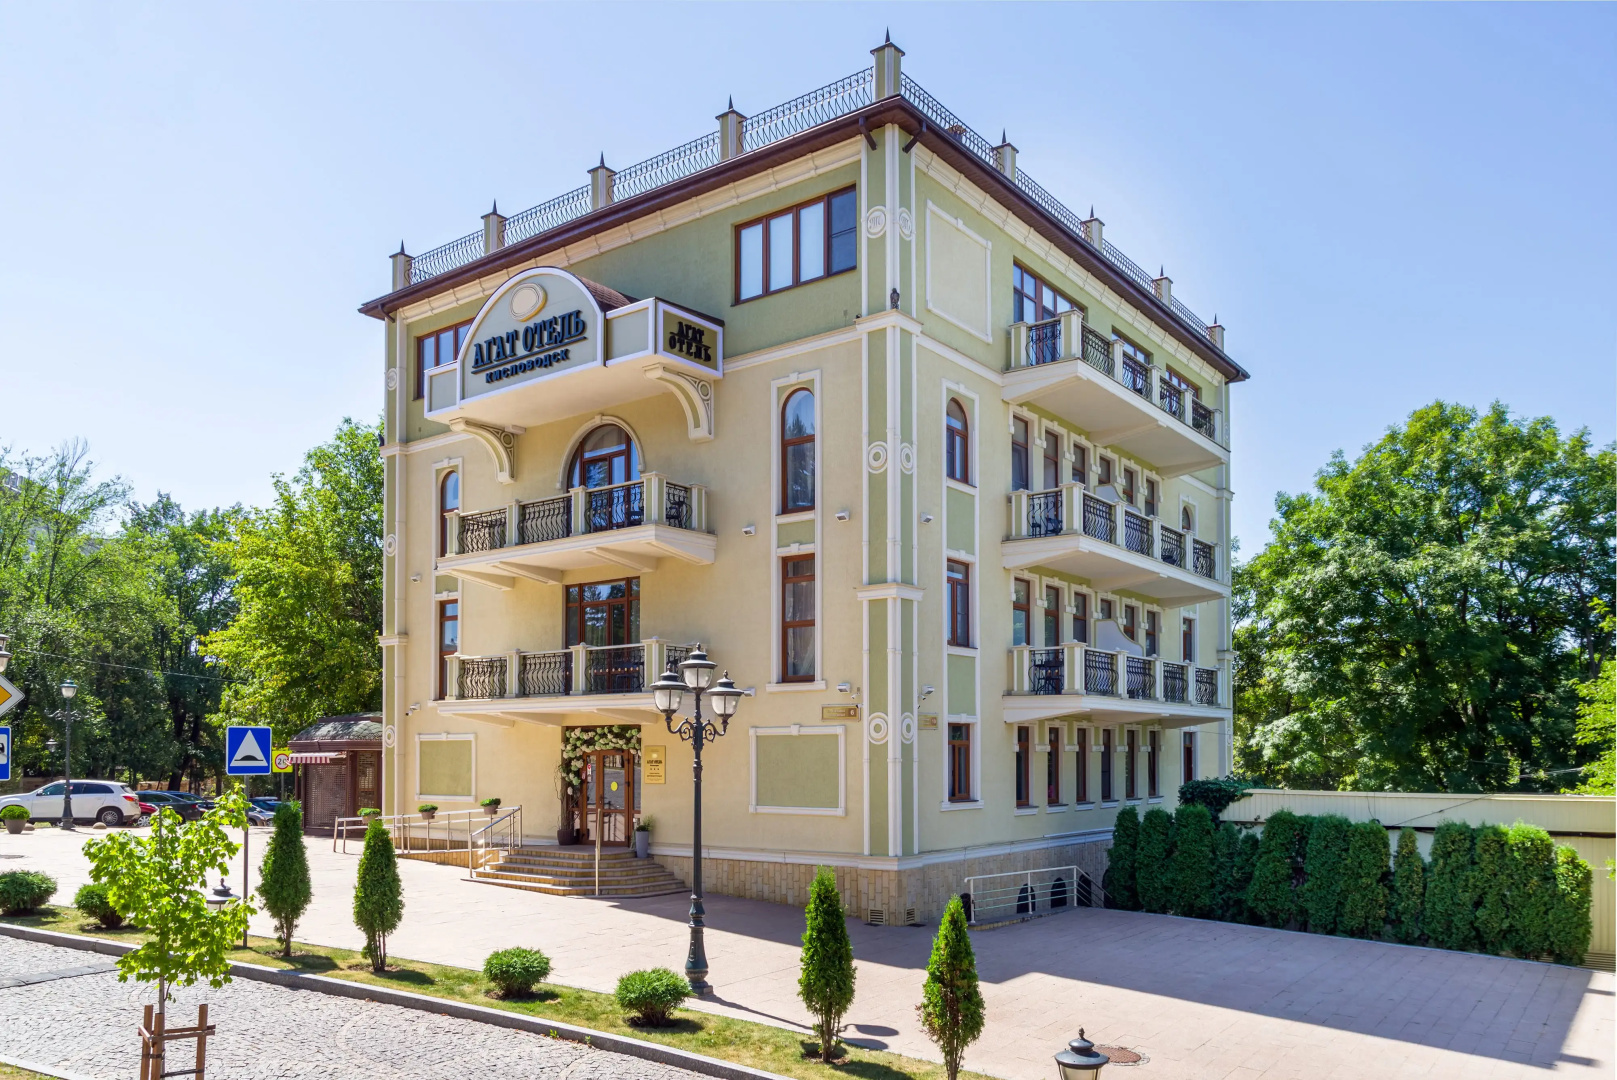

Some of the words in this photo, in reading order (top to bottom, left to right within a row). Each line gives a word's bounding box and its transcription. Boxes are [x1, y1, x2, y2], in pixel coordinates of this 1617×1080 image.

[472, 329, 519, 368] АГАТ
[522, 309, 586, 352] ОТЕЛЬ
[677, 321, 705, 344] АГАТ
[669, 335, 712, 362] ОТЕЛЬ
